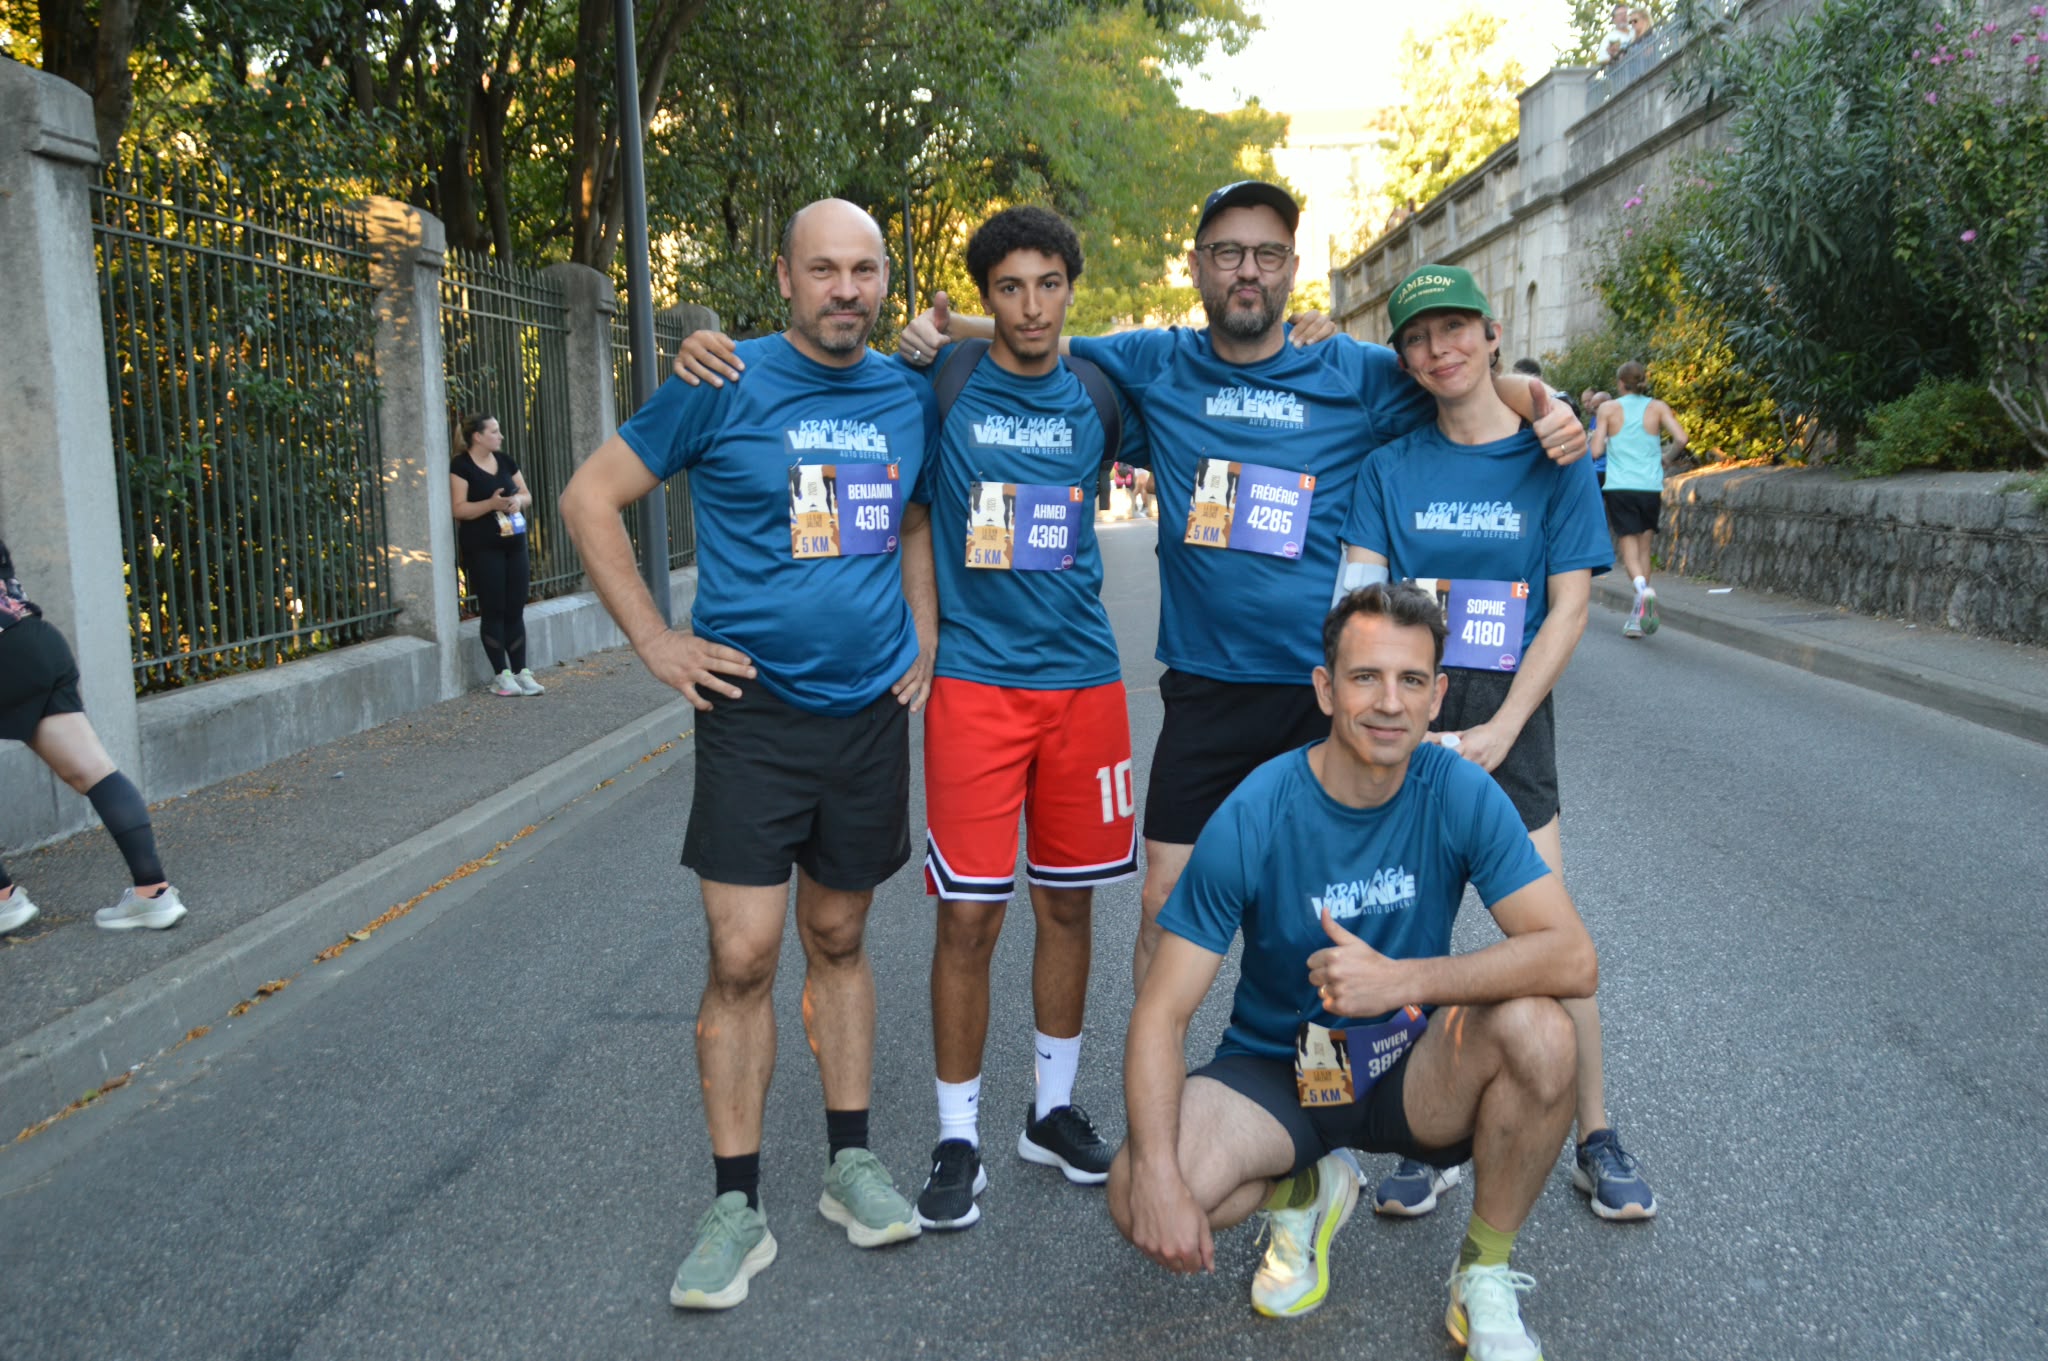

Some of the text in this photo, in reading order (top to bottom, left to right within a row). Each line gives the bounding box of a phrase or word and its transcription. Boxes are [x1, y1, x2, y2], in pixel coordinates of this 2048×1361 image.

[1398, 275, 1452, 304] JAMESON
[1217, 387, 1296, 405] KRAV MAGA
[1206, 397, 1304, 423] VALENCE
[800, 418, 877, 436] KRAV MAGA
[986, 415, 1066, 431] KRAV MAGA
[1249, 418, 1304, 430] AUTO DEFENSE
[787, 430, 889, 453] VALENCE
[973, 424, 1072, 447] VALENCE
[848, 483, 893, 500] BENJAMIN
[1250, 482, 1299, 507] FRÉDÉRIC
[855, 505, 890, 531] 4316
[1033, 504, 1067, 520] AHMED
[1427, 501, 1513, 517] KRAV MAGA
[1247, 505, 1294, 535] 4285
[1415, 512, 1521, 532] VALENCE
[1028, 524, 1068, 549] 4360
[1193, 524, 1220, 543] 5 KM
[1462, 530, 1520, 540] AUTO DEFENSE
[802, 536, 829, 553] 5 KM
[975, 549, 1001, 565] 5 KM
[1467, 599, 1506, 616] SOPHIE
[1462, 620, 1506, 647] 4180
[1096, 757, 1136, 824] 10
[1326, 864, 1405, 901] KRAV AGA
[1311, 874, 1416, 920] VALNCE
[1372, 1029, 1408, 1054] VIVIEN
[1309, 1088, 1341, 1103] 5 KM
